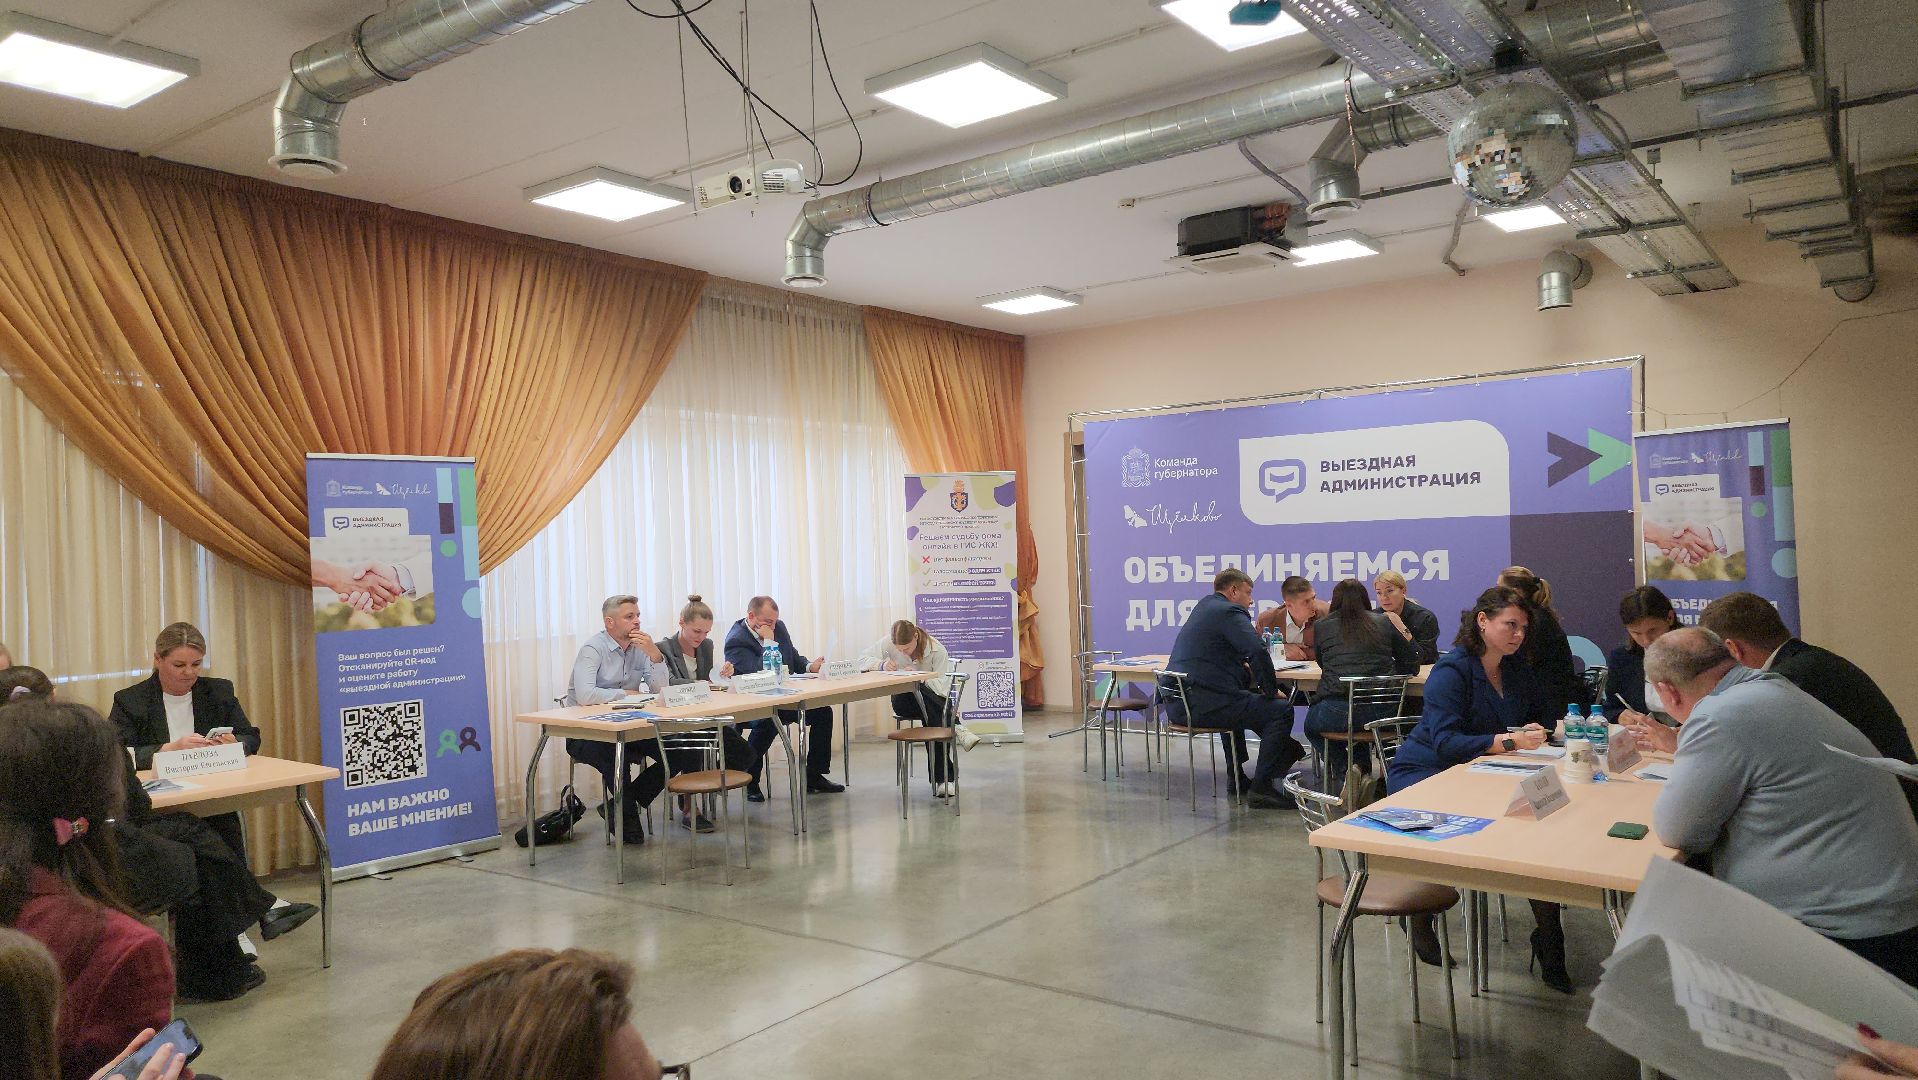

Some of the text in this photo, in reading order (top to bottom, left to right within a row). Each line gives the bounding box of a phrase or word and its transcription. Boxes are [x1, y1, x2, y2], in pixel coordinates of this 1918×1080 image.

[1154, 457, 1198, 468] Команда
[1320, 454, 1416, 473] ВЫЕЗДНАЯ
[1154, 467, 1218, 481] губернатора
[1320, 471, 1481, 494] АДМИНИСТРАЦИЯ
[960, 541, 977, 549] ГИС
[978, 541, 998, 549] ЖКХ!
[338, 644, 445, 662] Ваш вопрос был решен?
[338, 657, 437, 672] Отсканируйте QR-код
[338, 668, 419, 684] и оцените работу
[339, 674, 466, 694] «выездной администрации»
[347, 787, 450, 818] НАМ ВАЖНО
[348, 801, 473, 837] ВАШЕ МНЕНИЕ!
